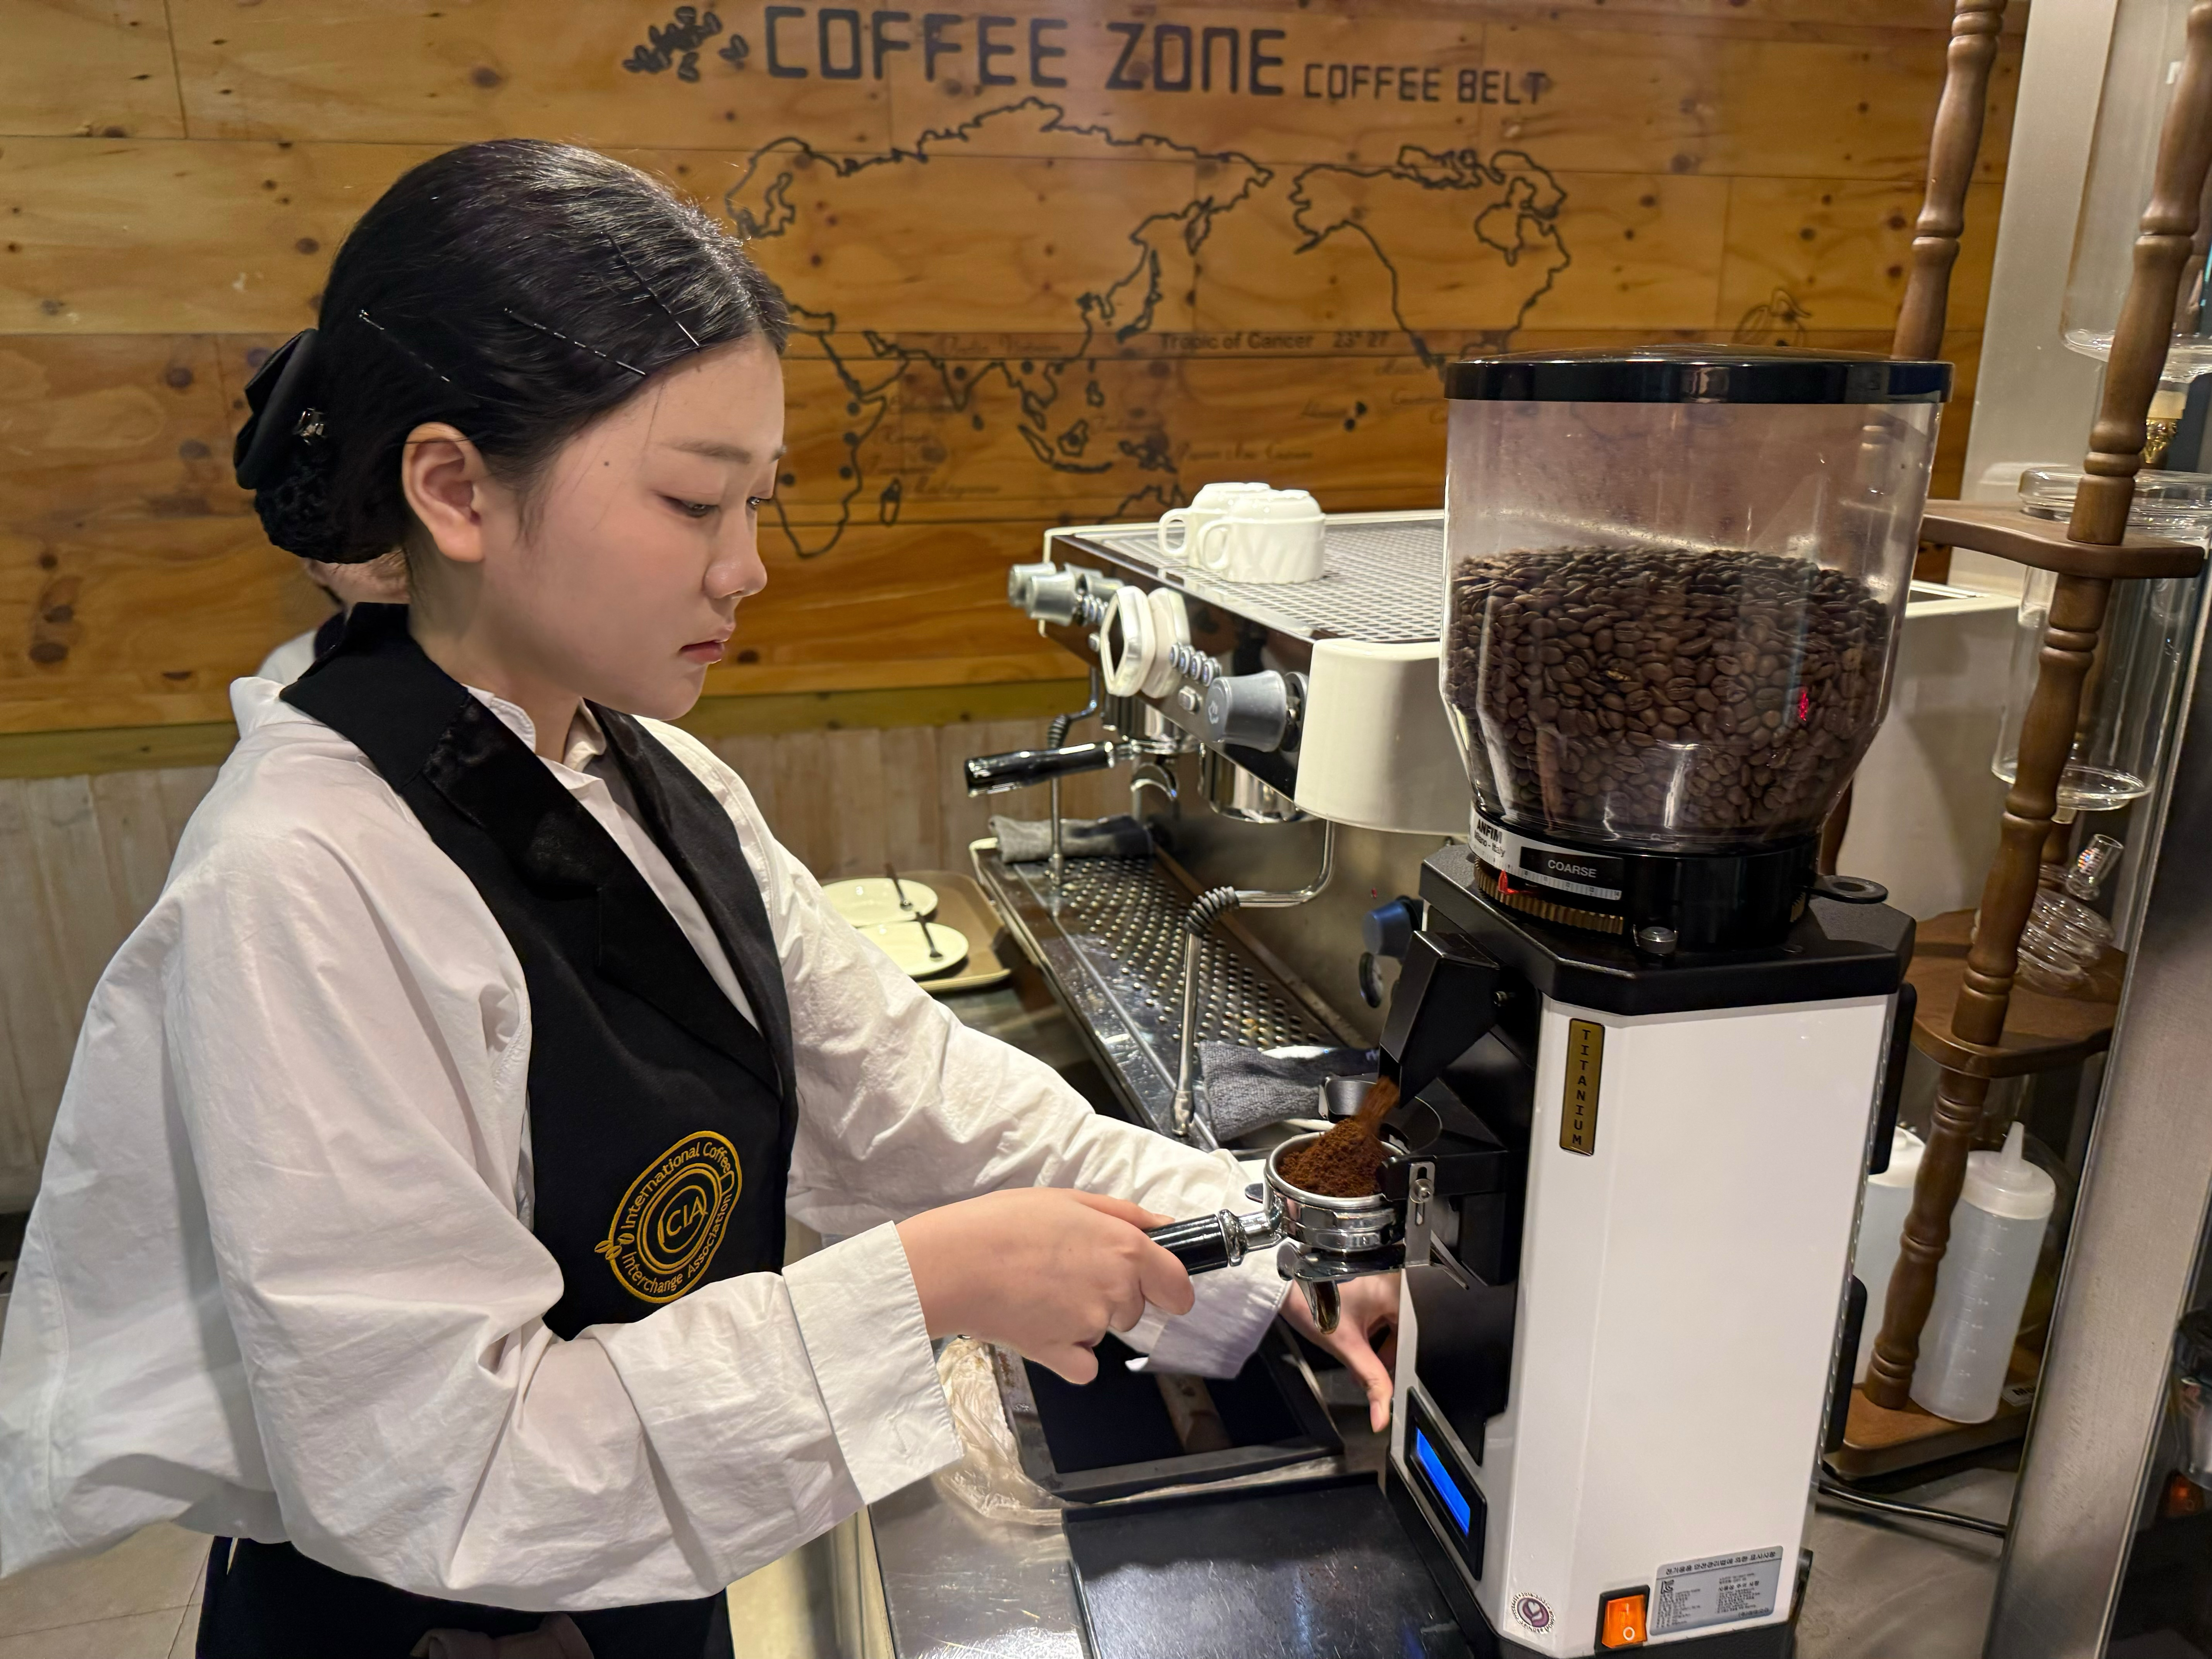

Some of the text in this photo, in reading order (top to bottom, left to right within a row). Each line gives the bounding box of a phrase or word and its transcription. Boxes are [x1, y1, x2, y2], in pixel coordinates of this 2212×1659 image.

[764, 6, 1286, 96] COFFEE ZONE
[1304, 64, 1547, 104] COFFEE BELT
[1161, 333, 1218, 352] Tropic
[1223, 331, 1242, 349] of
[1247, 331, 1313, 349] Cancer
[1476, 819, 1503, 844] ANFIM
[1548, 860, 1597, 878] COARSE
[1572, 1029, 1591, 1146] TITANIUM
[621, 1142, 731, 1229] International Coffee
[666, 1196, 708, 1236] CIA
[622, 1194, 732, 1293] Interchange Association
